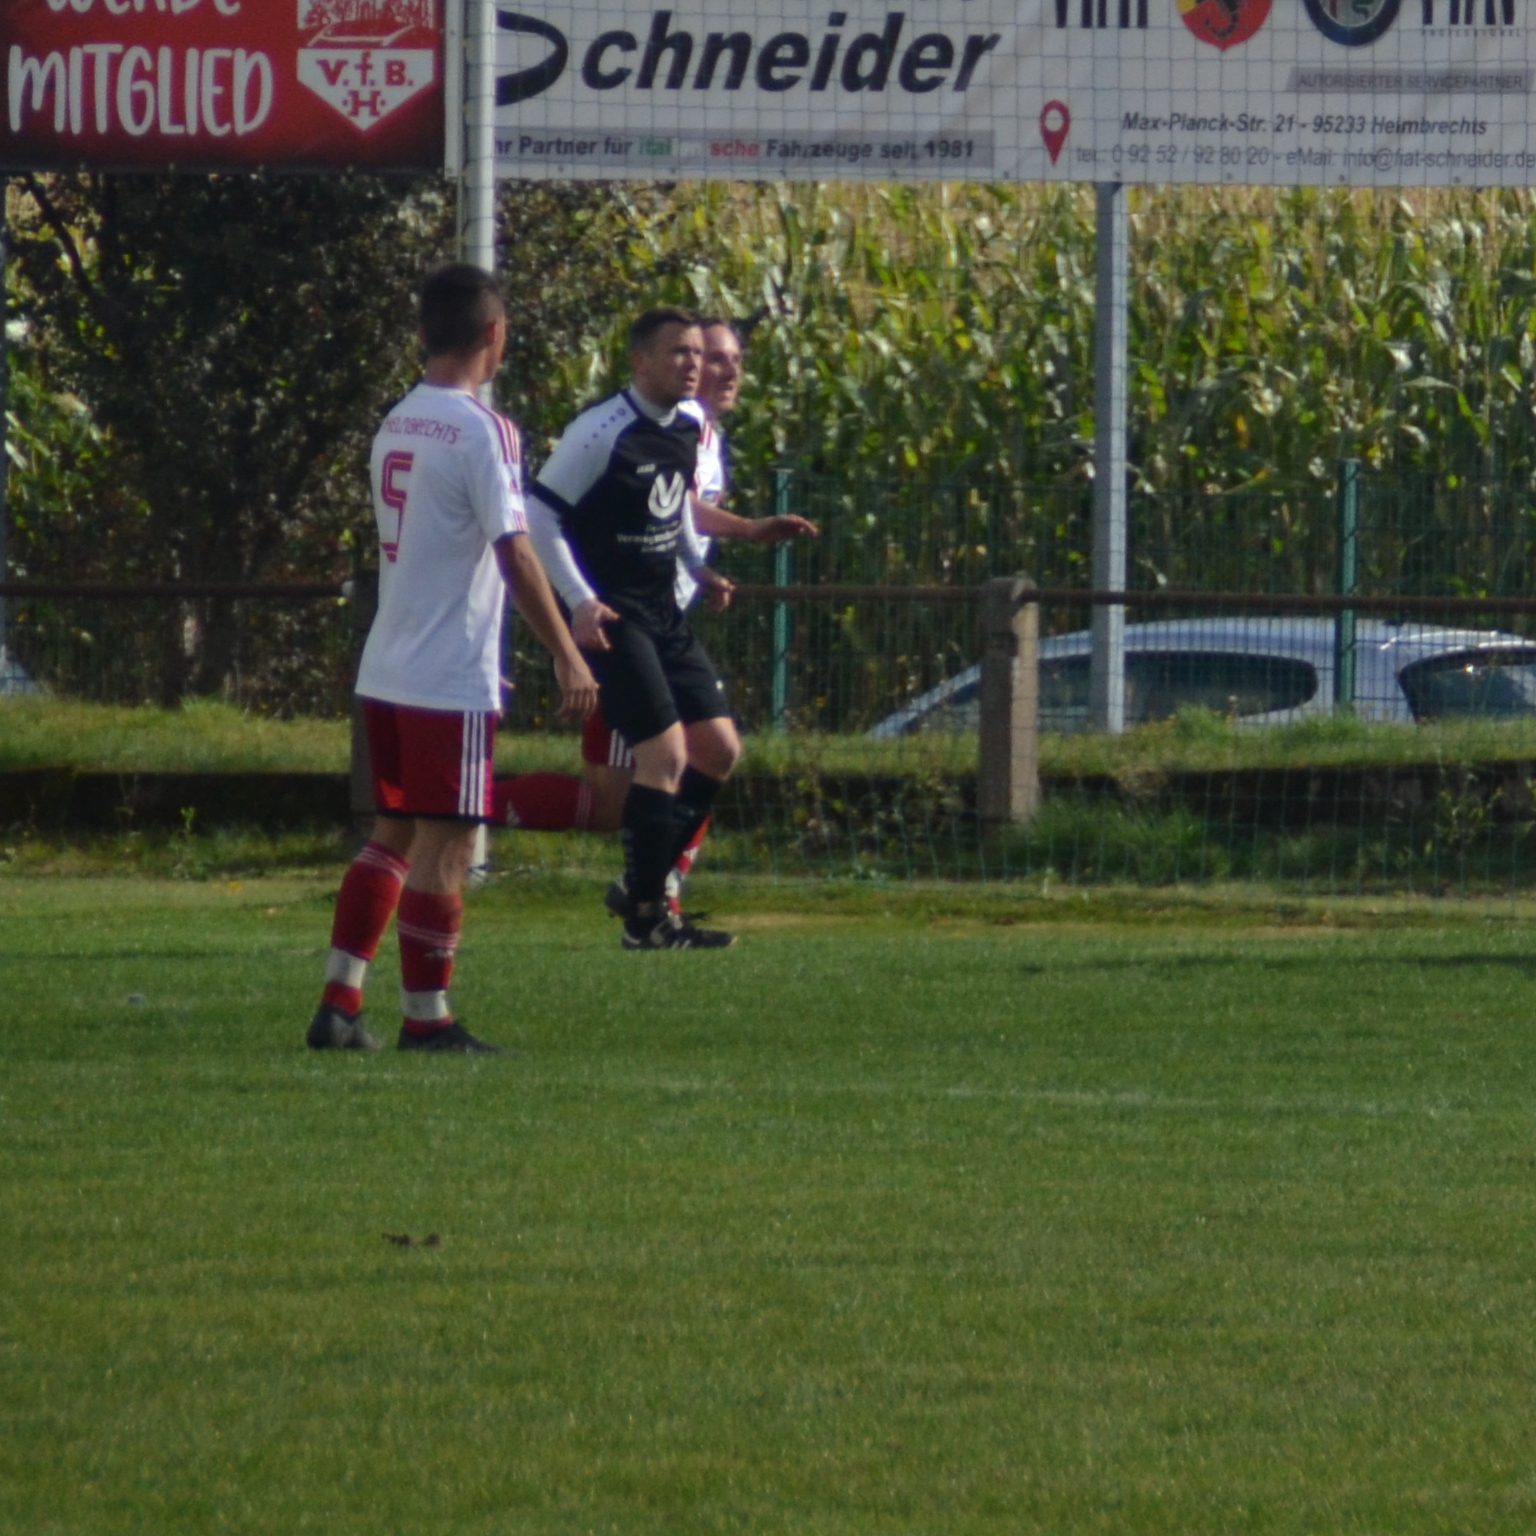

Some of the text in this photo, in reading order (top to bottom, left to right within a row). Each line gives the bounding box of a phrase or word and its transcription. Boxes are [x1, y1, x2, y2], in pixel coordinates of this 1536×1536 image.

[8, 43, 273, 136] MITGLIED
[518, 136, 598, 156] Partner
[604, 135, 633, 155] für
[766, 137, 872, 163] Fahrzeuge
[924, 139, 974, 158] 1981
[1122, 112, 1266, 134] Max-Planck-Str.
[1274, 114, 1294, 133] 21
[1312, 115, 1366, 135] 95233
[381, 449, 414, 563] 5
